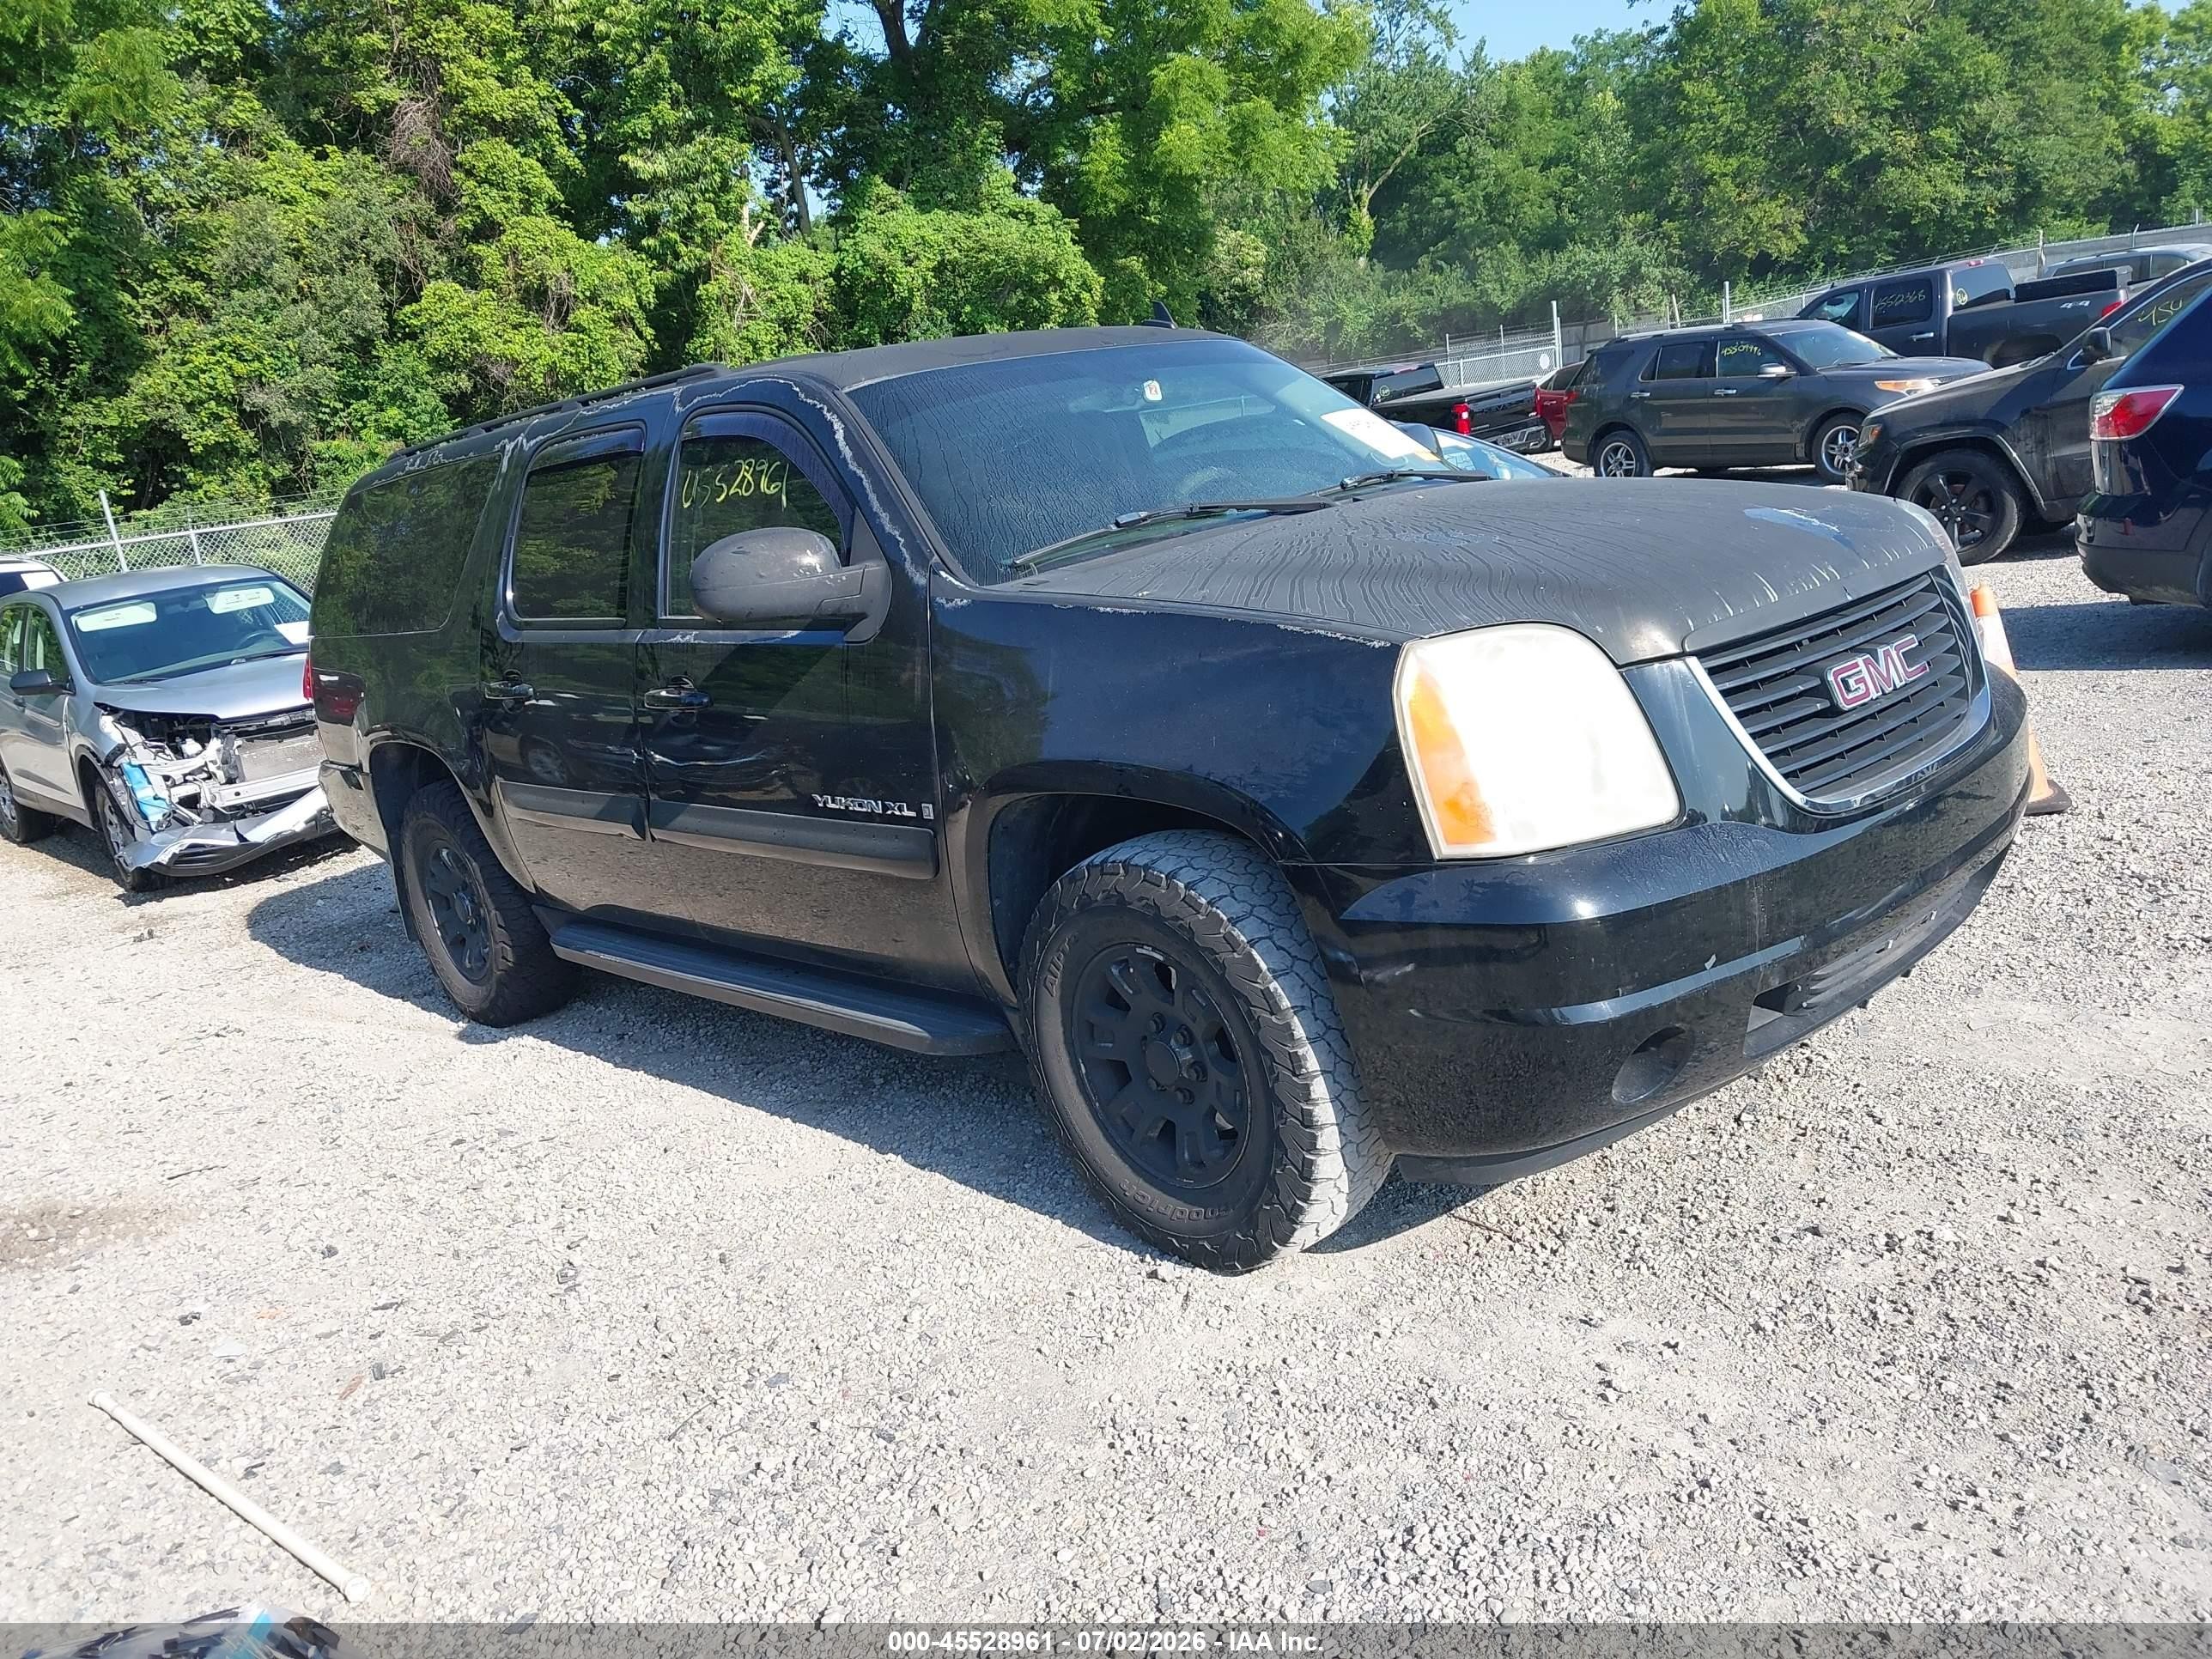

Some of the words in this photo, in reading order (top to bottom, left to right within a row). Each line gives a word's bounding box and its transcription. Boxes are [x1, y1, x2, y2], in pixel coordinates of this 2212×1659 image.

[1826, 633, 1930, 711] GMC
[811, 793, 883, 814] YUKON
[884, 801, 917, 817] XL
